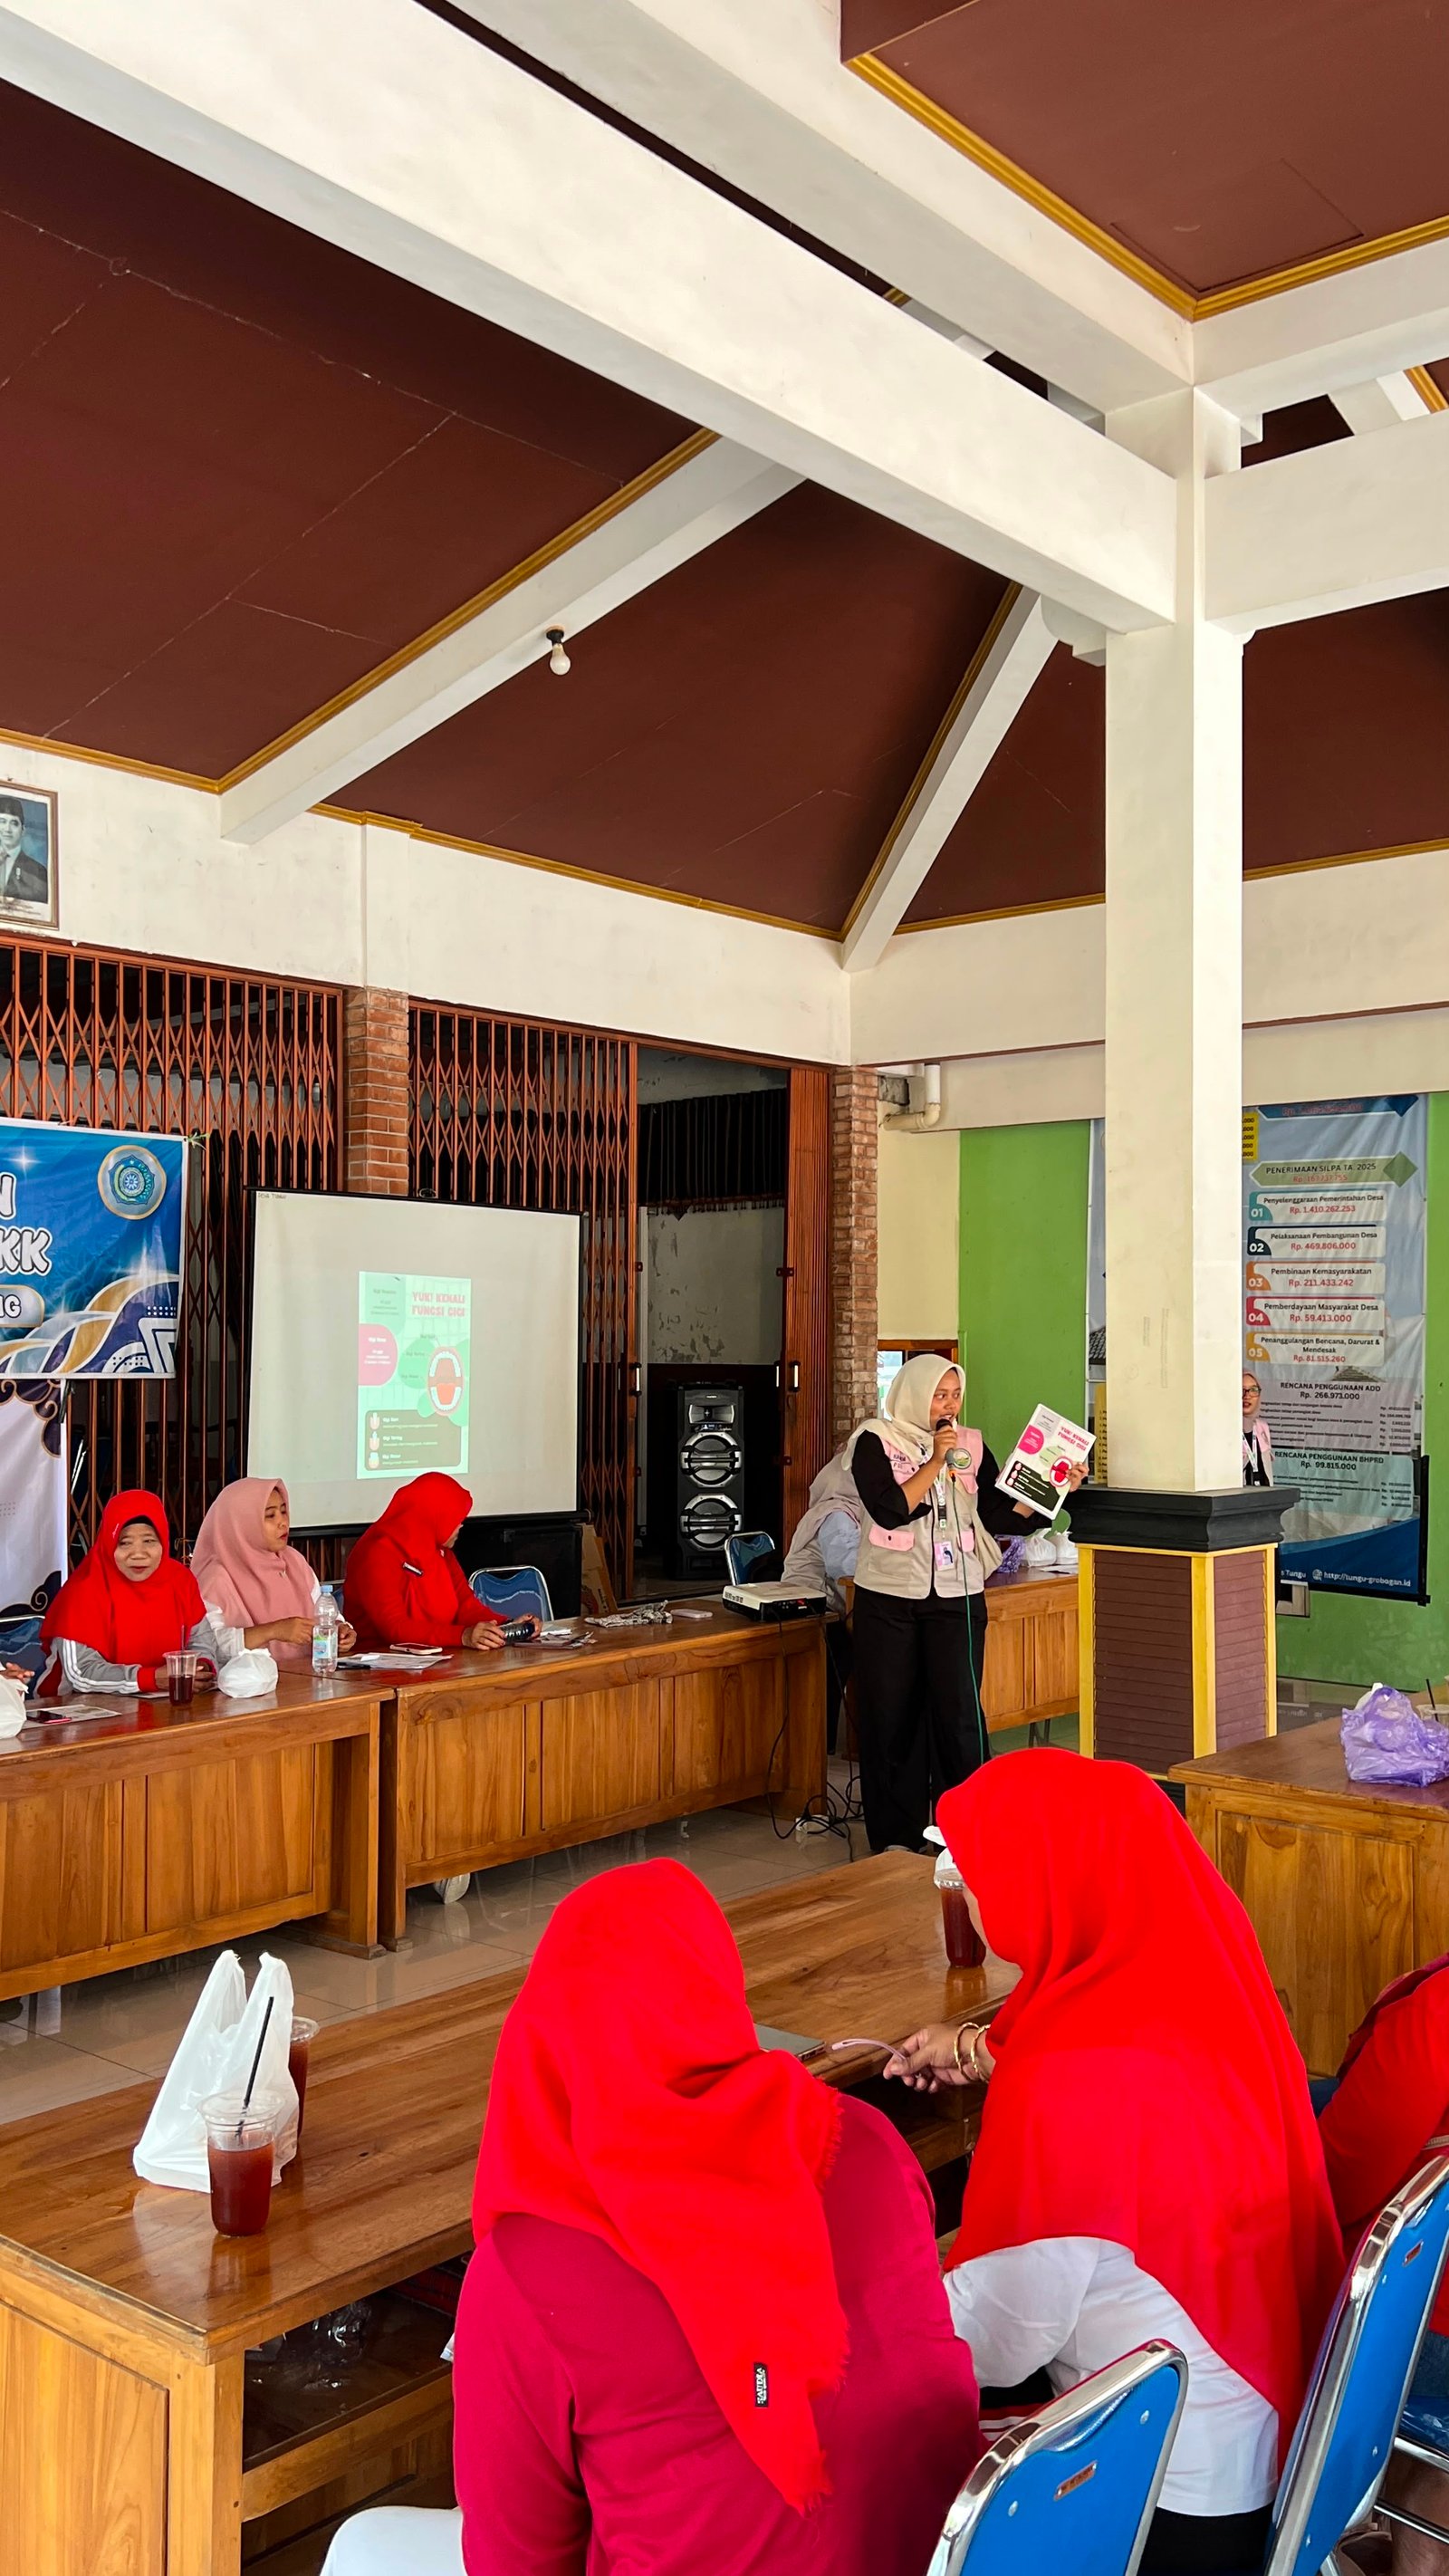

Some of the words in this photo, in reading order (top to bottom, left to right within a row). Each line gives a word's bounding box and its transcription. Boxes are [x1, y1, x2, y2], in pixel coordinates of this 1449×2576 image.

[1251, 1208, 1263, 1217] 01
[1290, 1206, 1301, 1215] Rp.
[1250, 1243, 1264, 1253] 02
[1291, 1243, 1302, 1251] Rp.
[1312, 1268, 1372, 1276] Kemasyarakatan
[1249, 1278, 1262, 1287] 03
[1289, 1279, 1301, 1287] Rp.
[1318, 1303, 1358, 1312] Masyarakat
[1249, 1313, 1264, 1322] 04
[1290, 1314, 1302, 1322] Rp.
[1249, 1349, 1262, 1357] 05
[1274, 1451, 1308, 1459] RENCANA
[1309, 1454, 1358, 1462] PENGGUNAAN
[1285, 1570, 1306, 1579] Tungu
[1324, 1572, 1411, 1587] http://tungu-grobogan.id
